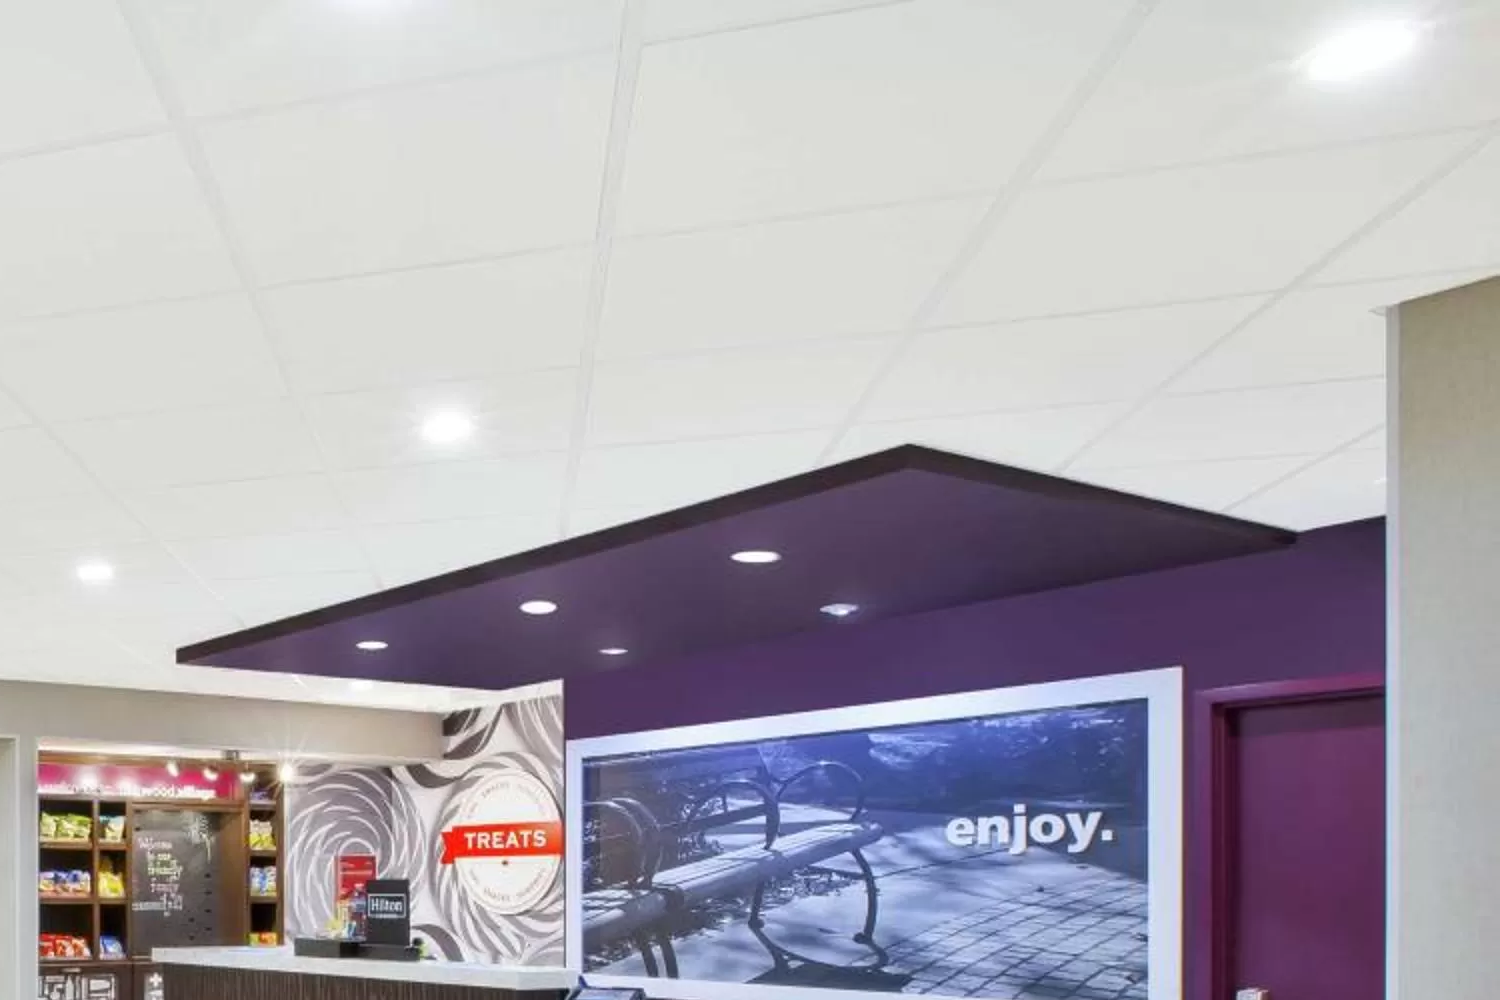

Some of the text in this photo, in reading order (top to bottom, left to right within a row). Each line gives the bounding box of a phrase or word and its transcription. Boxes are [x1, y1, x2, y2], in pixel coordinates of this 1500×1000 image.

[463, 829, 547, 849] TREATS
[946, 803, 1114, 855] enjoy.
[371, 898, 403, 912] Hilton
